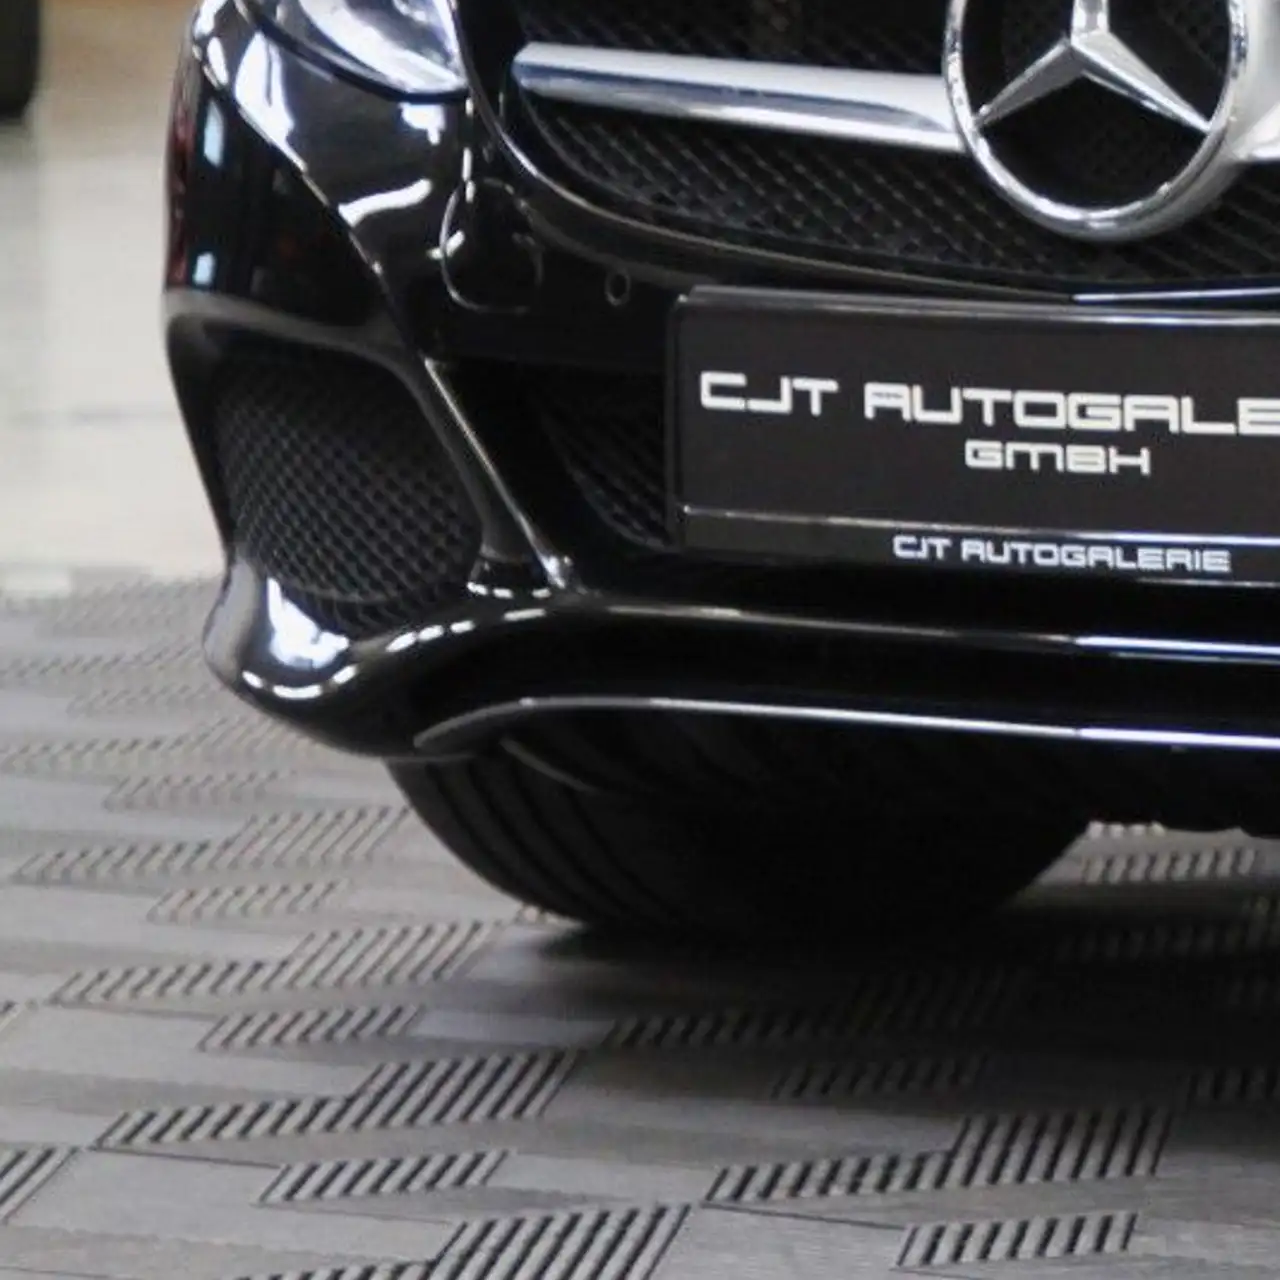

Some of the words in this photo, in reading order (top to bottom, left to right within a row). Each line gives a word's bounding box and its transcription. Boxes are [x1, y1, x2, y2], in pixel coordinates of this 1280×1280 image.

[700, 370, 839, 417] CJT
[892, 534, 952, 561] CJT
[960, 538, 1232, 573] AUTOGALERIE
